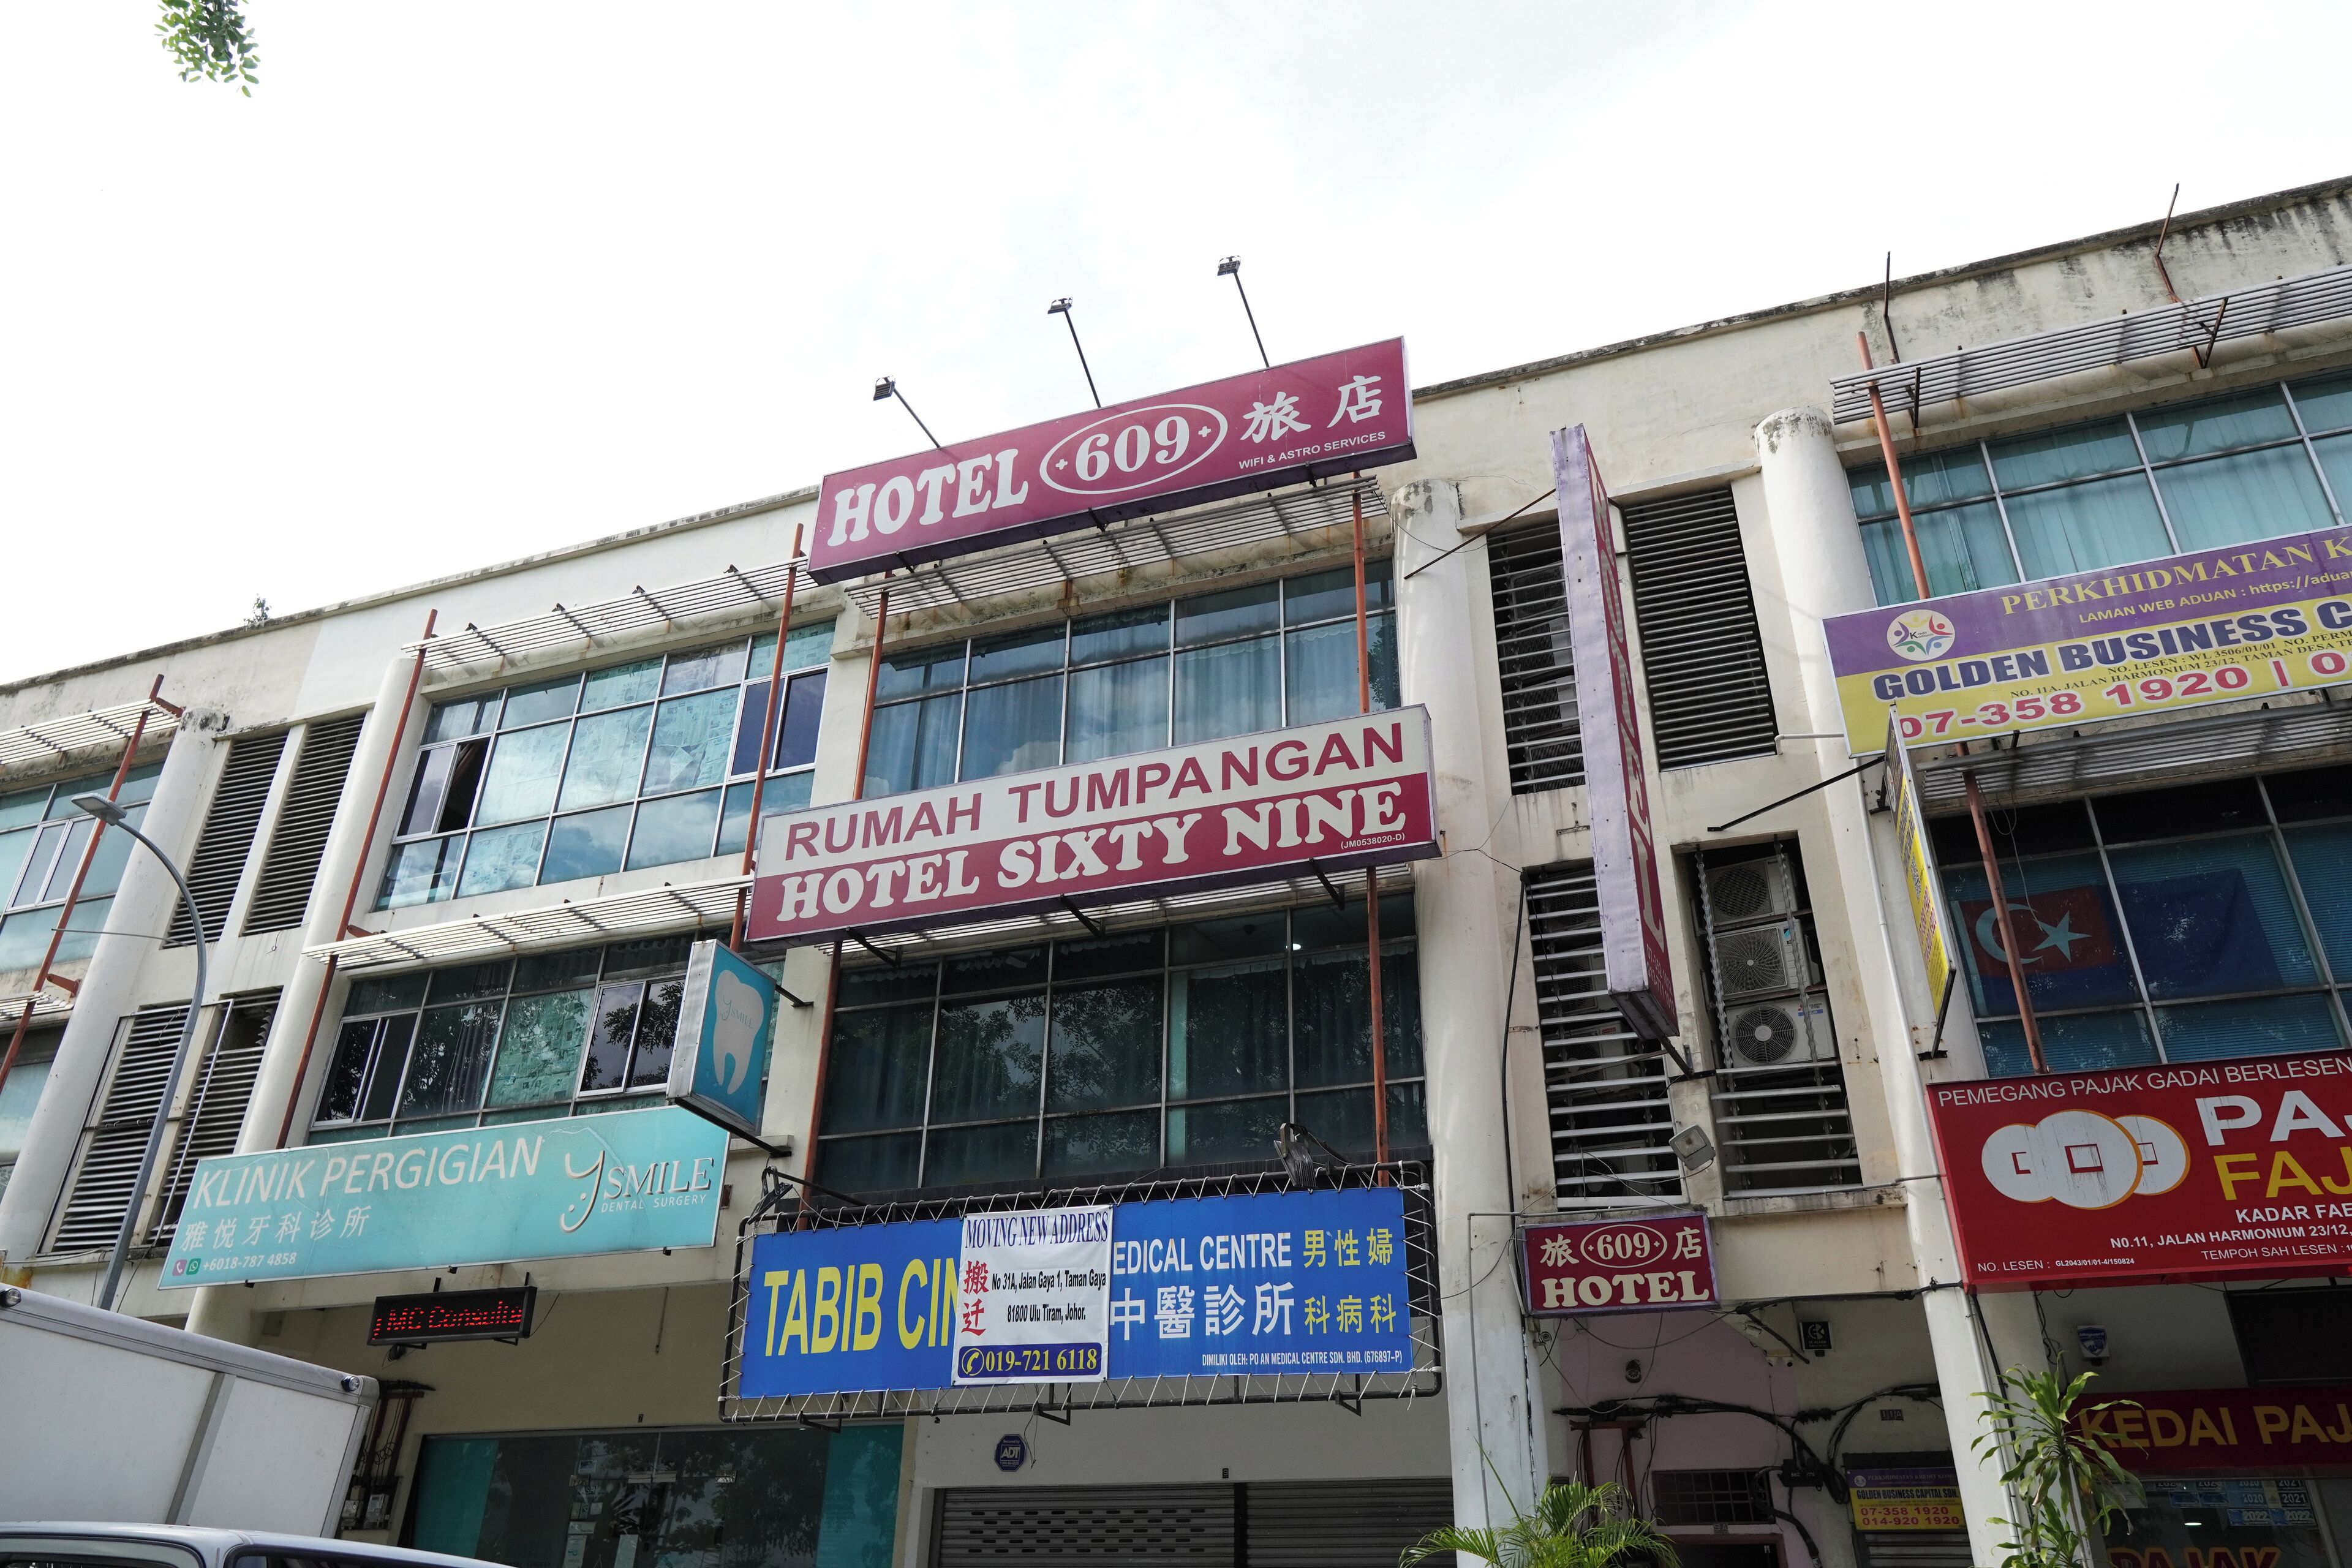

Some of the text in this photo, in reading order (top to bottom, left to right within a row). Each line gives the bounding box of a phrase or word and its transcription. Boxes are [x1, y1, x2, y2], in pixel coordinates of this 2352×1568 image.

[1238, 431, 1385, 469] WIFI & ASTRO SERVICES
[827, 415, 1190, 547] HOTEL 609
[1999, 543, 2313, 615] PERKHIDMATAN
[2079, 606, 2136, 624] LAMAN
[2138, 600, 2175, 615] WEB
[2180, 589, 2236, 607] ADUAN
[1874, 650, 2049, 700] GOLDEN
[2058, 609, 2308, 672] BUSINESS
[2011, 689, 2034, 698] NO.
[2064, 677, 2107, 689] JALAN
[2111, 663, 2200, 682] HARMONIUM
[2204, 658, 2239, 668] 23/12,
[2241, 648, 2293, 662] TAMAN
[2297, 643, 2335, 654] DESA
[2108, 665, 2131, 674] NO.
[2134, 658, 2177, 671] LESEN
[2188, 653, 2212, 662] WL
[2215, 643, 2277, 658] 3506/01/01
[2283, 637, 2308, 646] NO.
[1588, 453, 1664, 954] HOTEL
[1899, 693, 2082, 739] 07-358
[2106, 667, 2248, 705] 1920
[785, 723, 1403, 861] RUMAH TUMPANGAN
[776, 782, 1406, 922] HOTEL SIXTY NINE
[1341, 832, 1405, 850] (JM0538020-D)
[1938, 1057, 2352, 1107] PEMEGANG PAJAK GADAI BERLESEN
[2195, 1090, 2352, 1146] PA
[193, 1136, 543, 1209] KLINIK PERGIGIAN
[601, 1194, 706, 1213] DENTAL SURGERY
[2236, 1205, 2311, 1223] KADAR
[180, 1205, 371, 1252] 雅悦牙科诊所
[965, 1211, 1108, 1248] MOVING NEW ADDRESS
[1597, 1232, 1651, 1260] 609
[1672, 1226, 1702, 1260] 店
[2157, 1232, 2206, 1246] JALAN
[2209, 1226, 2305, 1242] HARMONIUM
[203, 1253, 297, 1272] +6018-787 4858
[1199, 1232, 1292, 1271] CENTRE
[1303, 1228, 1393, 1268] 男性婦
[1540, 1234, 1580, 1267] 旅
[1977, 1262, 2000, 1272] NO.
[2003, 1260, 2043, 1271] LESEN
[2055, 1258, 2135, 1267] GL2043/01/01-4/150824
[2201, 1248, 2258, 1260] TEMPOH
[2261, 1246, 2289, 1257] SAH
[2292, 1244, 2337, 1255] LESEN
[992, 1273, 1001, 1290] No
[1003, 1272, 1017, 1293] 31A,
[1019, 1272, 1036, 1290] Jalan
[1038, 1271, 1055, 1293] Gaya
[1065, 1270, 1087, 1287] Taman
[1088, 1268, 1106, 1291] Gaya
[1541, 1270, 1709, 1308] HOTEL
[764, 1263, 883, 1357] TABIB
[1007, 1303, 1086, 1324] 81800 Ulu Tiram, Johor.
[1109, 1281, 1294, 1341] 中醫診所
[1304, 1293, 1396, 1335] 科病科
[986, 1348, 1098, 1372] 019-721 6118
[1202, 1350, 1402, 1366] DIMILIKI OLEH: PO AN MEDICAL CENTRE SDN. BHD. (676897-P)
[2079, 1403, 2352, 1448] KEDAI PAJ
[1001, 1446, 1020, 1458] ADT
[1856, 1490, 1881, 1499] GOLDEN
[1883, 1489, 1913, 1499] BUSINESS
[1916, 1488, 1942, 1498] CAPITAL
[1861, 1507, 1909, 1515] 07-358
[1863, 1516, 1959, 1525] 014-920 1920
